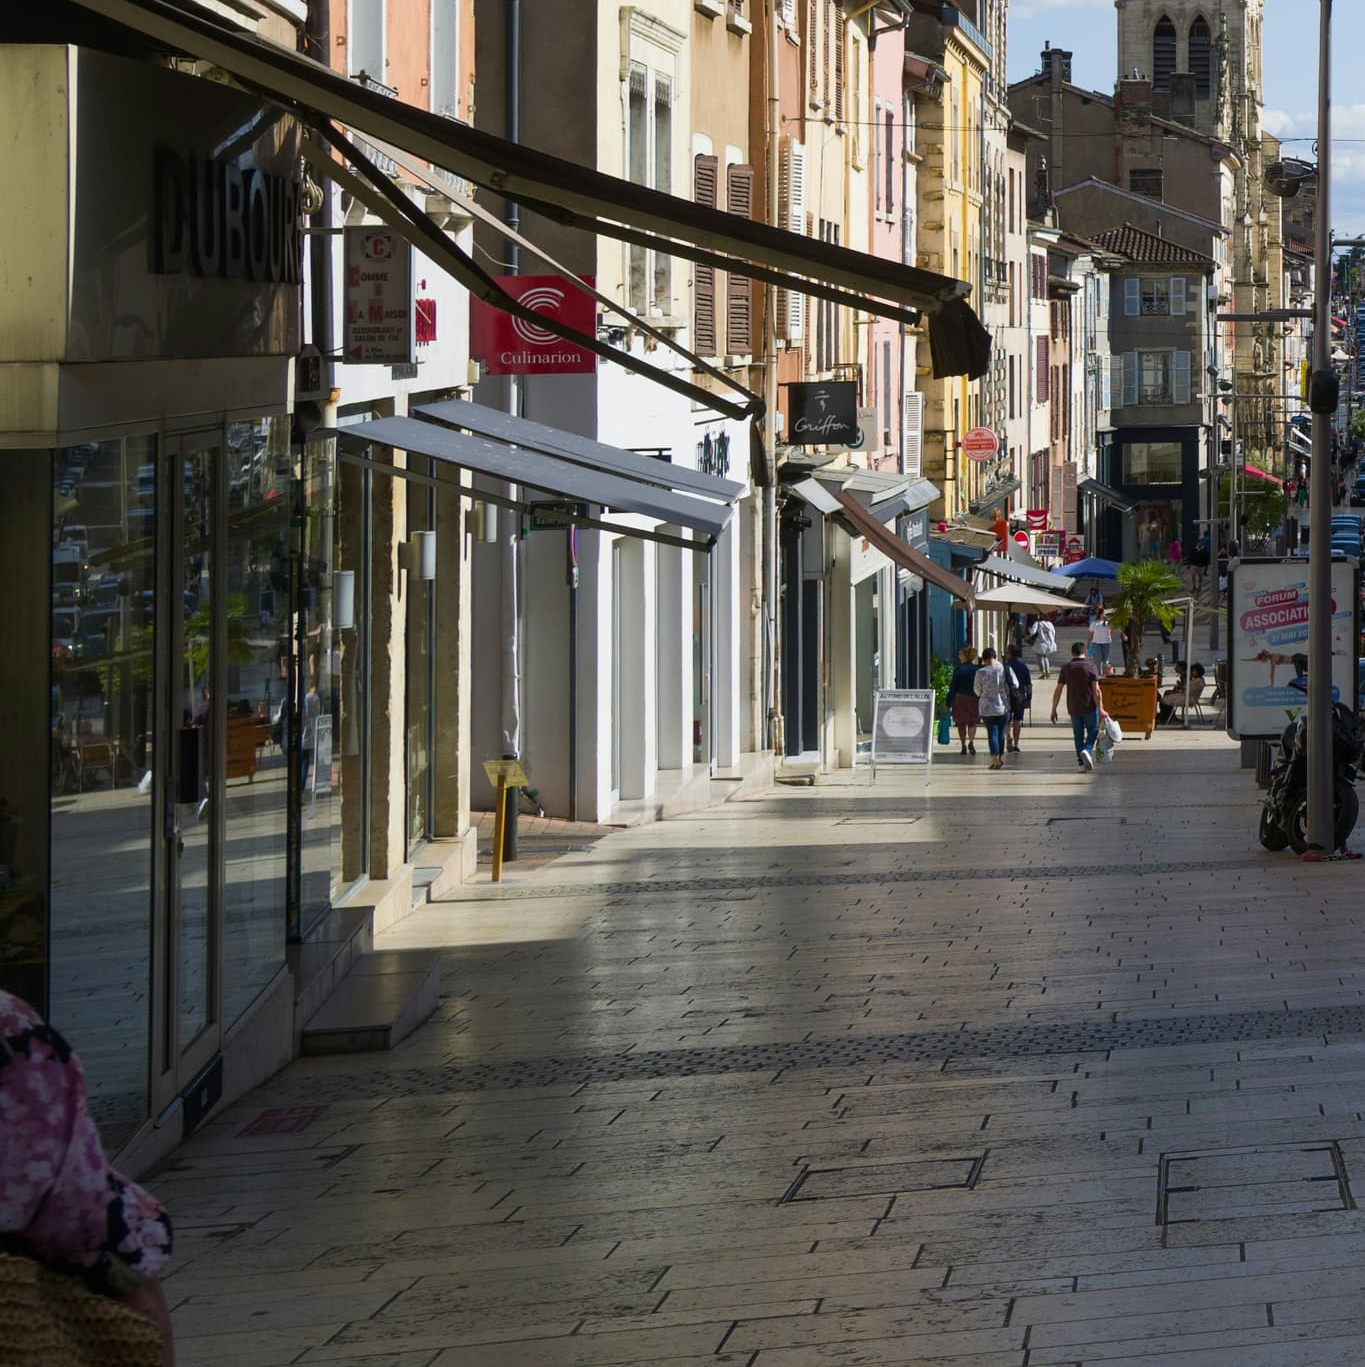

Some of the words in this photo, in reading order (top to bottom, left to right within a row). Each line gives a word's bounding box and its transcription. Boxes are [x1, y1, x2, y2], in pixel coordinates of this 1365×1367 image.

[500, 350, 581, 365] Culinarion
[794, 414, 850, 437] Griffon
[1256, 591, 1298, 606] FORUM
[1282, 632, 1297, 642] MAI
